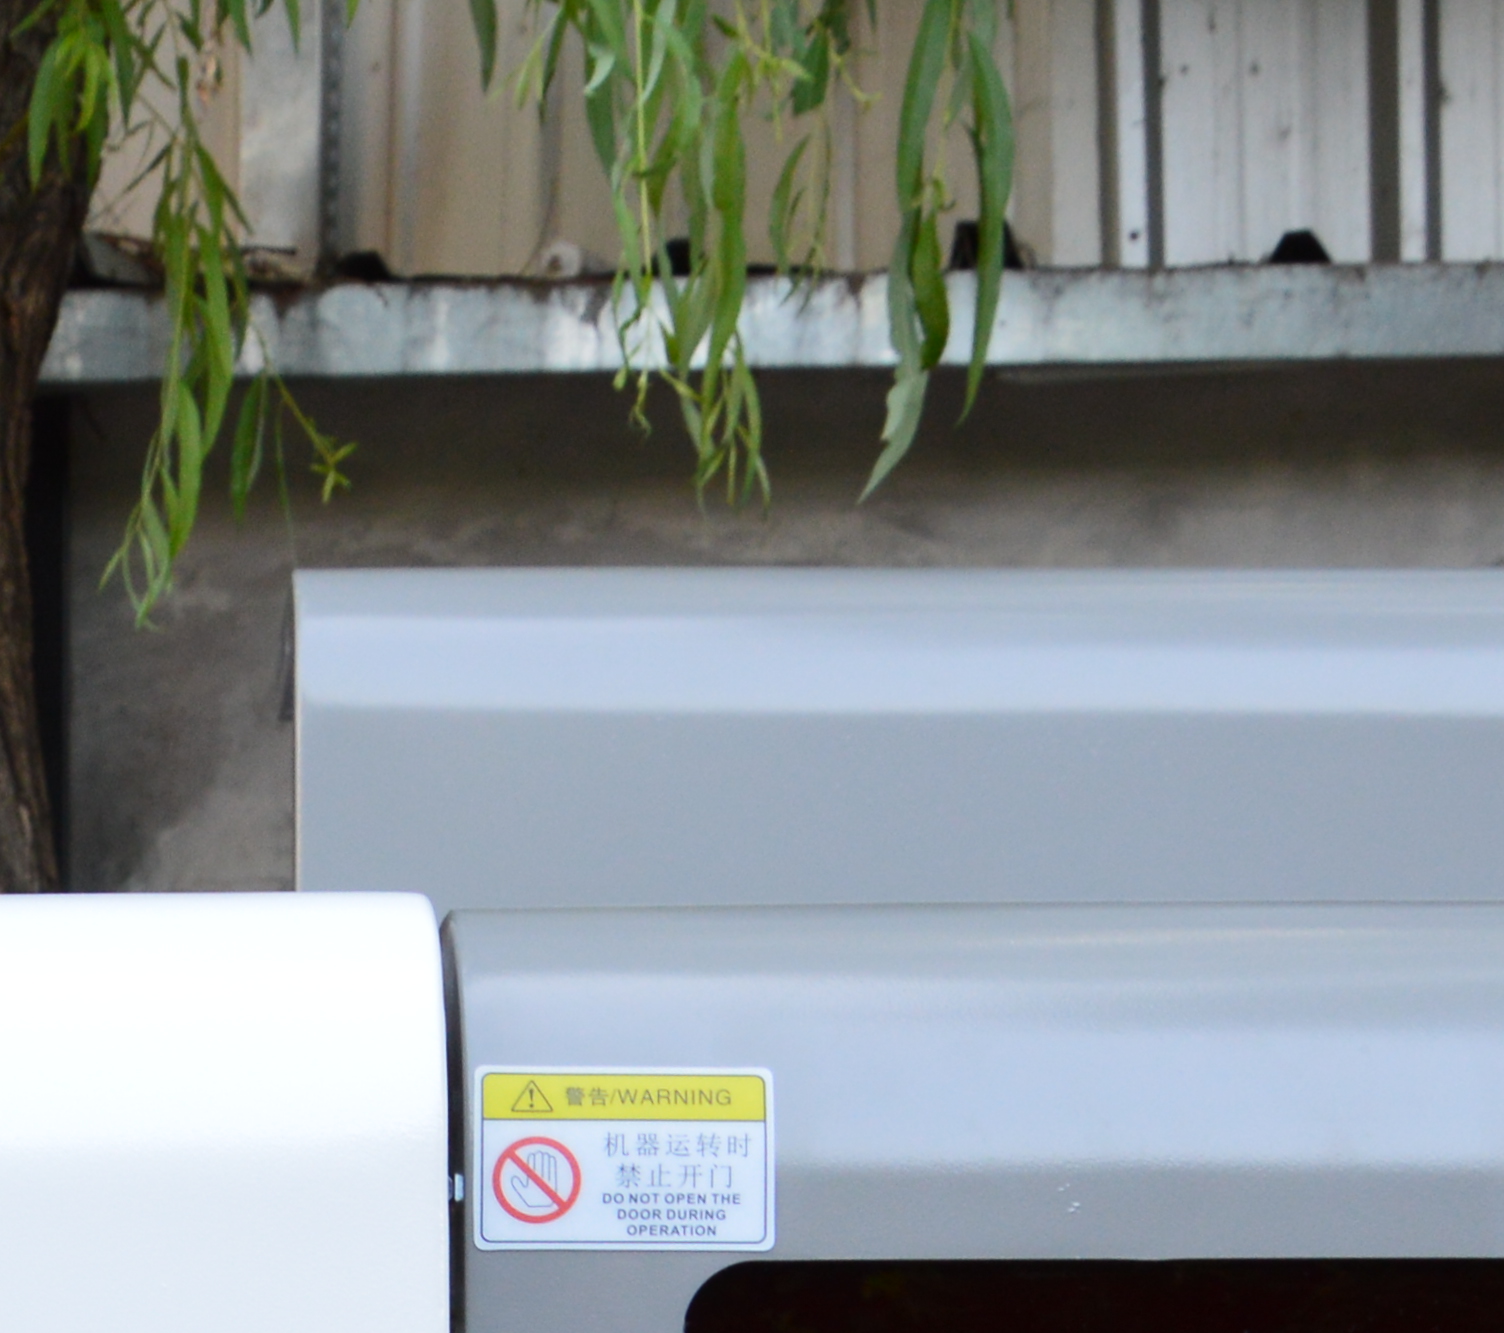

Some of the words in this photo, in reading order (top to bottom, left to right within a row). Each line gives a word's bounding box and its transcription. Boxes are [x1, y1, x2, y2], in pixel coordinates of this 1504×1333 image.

[564, 1085, 733, 1107] 警告/WARNING
[603, 1131, 753, 1159] 机器运转时
[616, 1163, 734, 1190] 禁止开门
[602, 1192, 625, 1205] DO
[628, 1192, 659, 1205] NOT
[664, 1192, 707, 1205] OPEN
[711, 1192, 741, 1205] THE
[617, 1208, 662, 1221] DOOR
[666, 1208, 727, 1221] DURING
[626, 1223, 717, 1237] OPERATION
